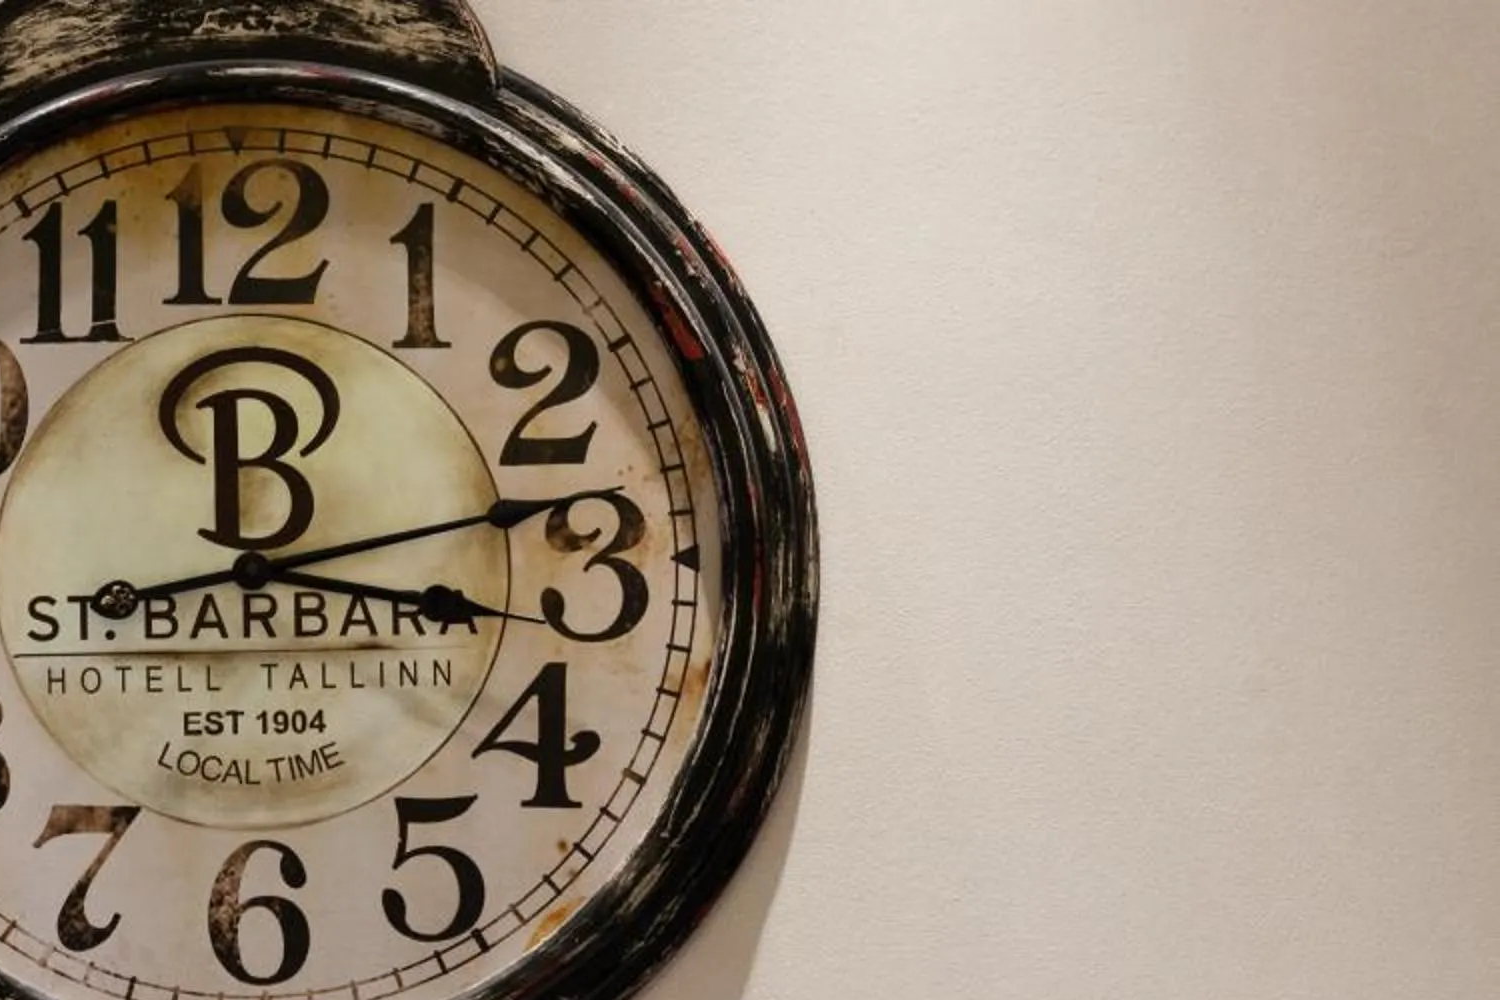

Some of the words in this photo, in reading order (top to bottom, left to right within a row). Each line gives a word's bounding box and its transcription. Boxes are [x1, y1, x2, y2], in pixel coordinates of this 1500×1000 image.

[20, 201, 135, 344] 11
[163, 159, 330, 305] 12
[390, 203, 452, 349] 1
[159, 346, 341, 551] B
[489, 320, 600, 466] 2
[27, 596, 116, 642] ST.
[540, 490, 649, 642] 3
[48, 664, 221, 695] HOTELL
[261, 660, 453, 690] TALLINN
[183, 710, 244, 736] EST
[256, 709, 326, 735] 1904
[471, 662, 601, 809] 4
[157, 741, 261, 785] LOCAL
[266, 741, 347, 784] TIME
[33, 805, 142, 952] 7
[208, 840, 311, 985] 6
[382, 794, 486, 943] 5
